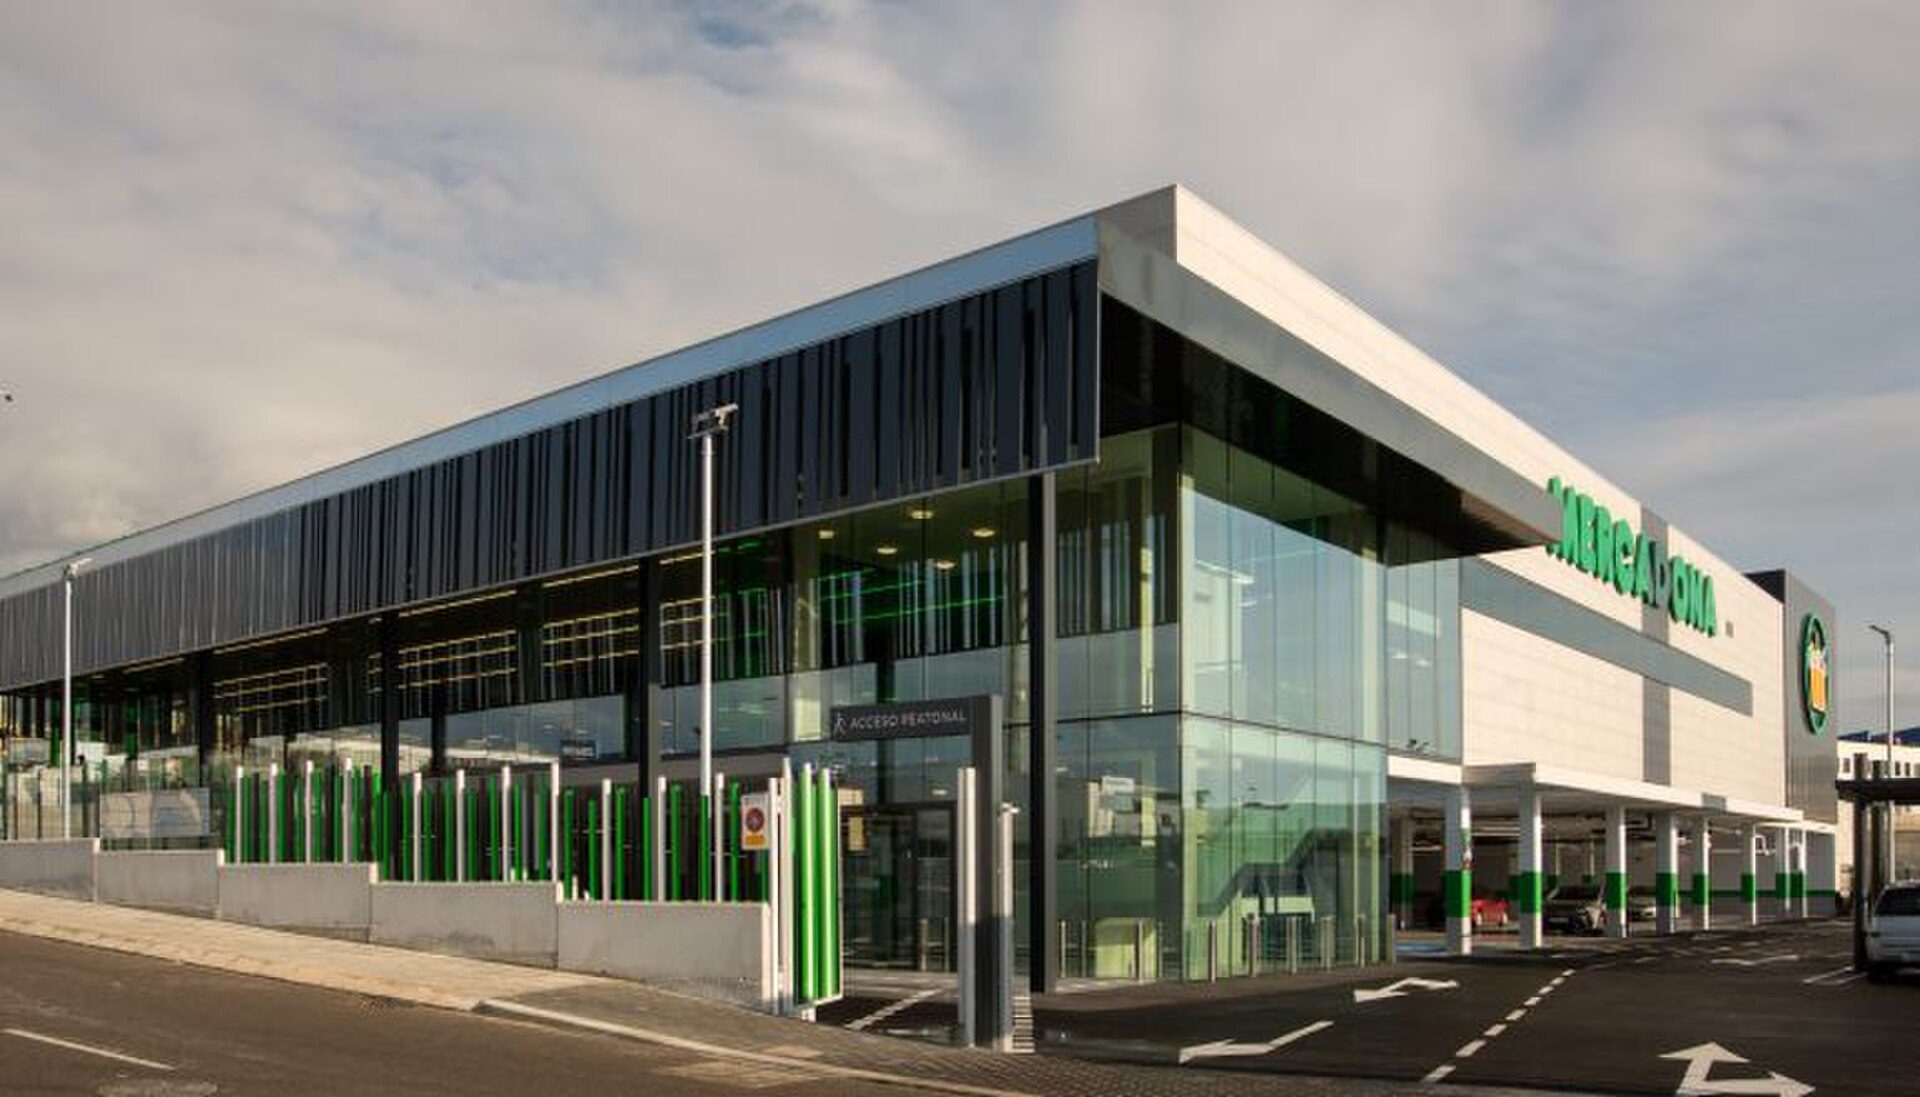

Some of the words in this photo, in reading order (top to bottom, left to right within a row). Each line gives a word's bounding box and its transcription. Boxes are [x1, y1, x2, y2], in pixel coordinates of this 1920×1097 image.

[1546, 476, 1717, 638] MERCADONA
[849, 714, 899, 730] ACCESO
[901, 708, 968, 727] PEATONAL
